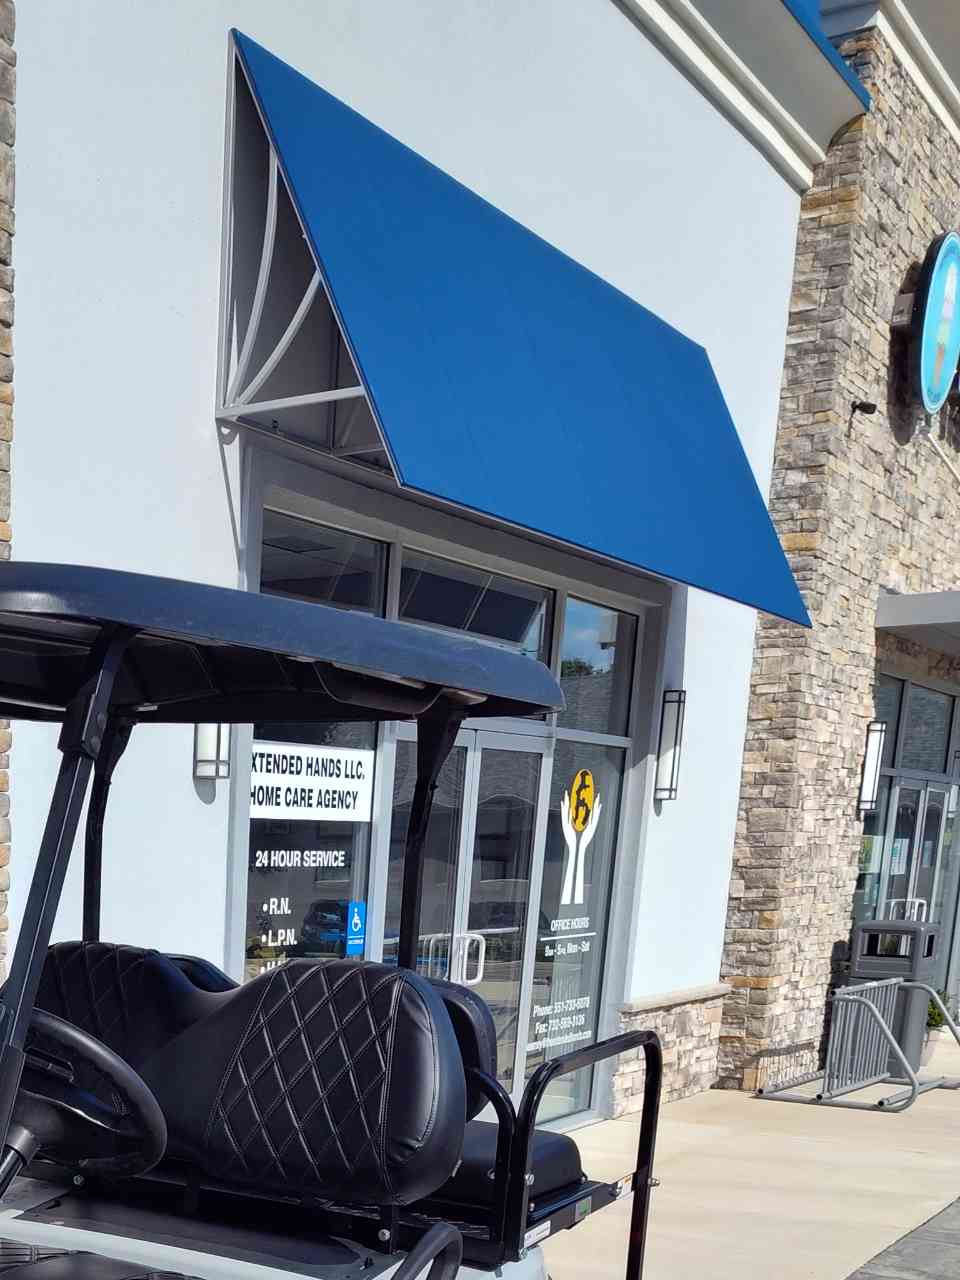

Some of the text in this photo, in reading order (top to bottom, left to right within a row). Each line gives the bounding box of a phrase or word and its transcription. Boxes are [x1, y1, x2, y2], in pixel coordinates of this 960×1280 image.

[251, 751, 303, 776] XTENDED
[305, 756, 342, 778] HANDS
[250, 785, 359, 810] HOME CARE AGENCY
[255, 850, 345, 867] 24 HOUR SERVICE
[550, 918, 571, 932] OFFICE
